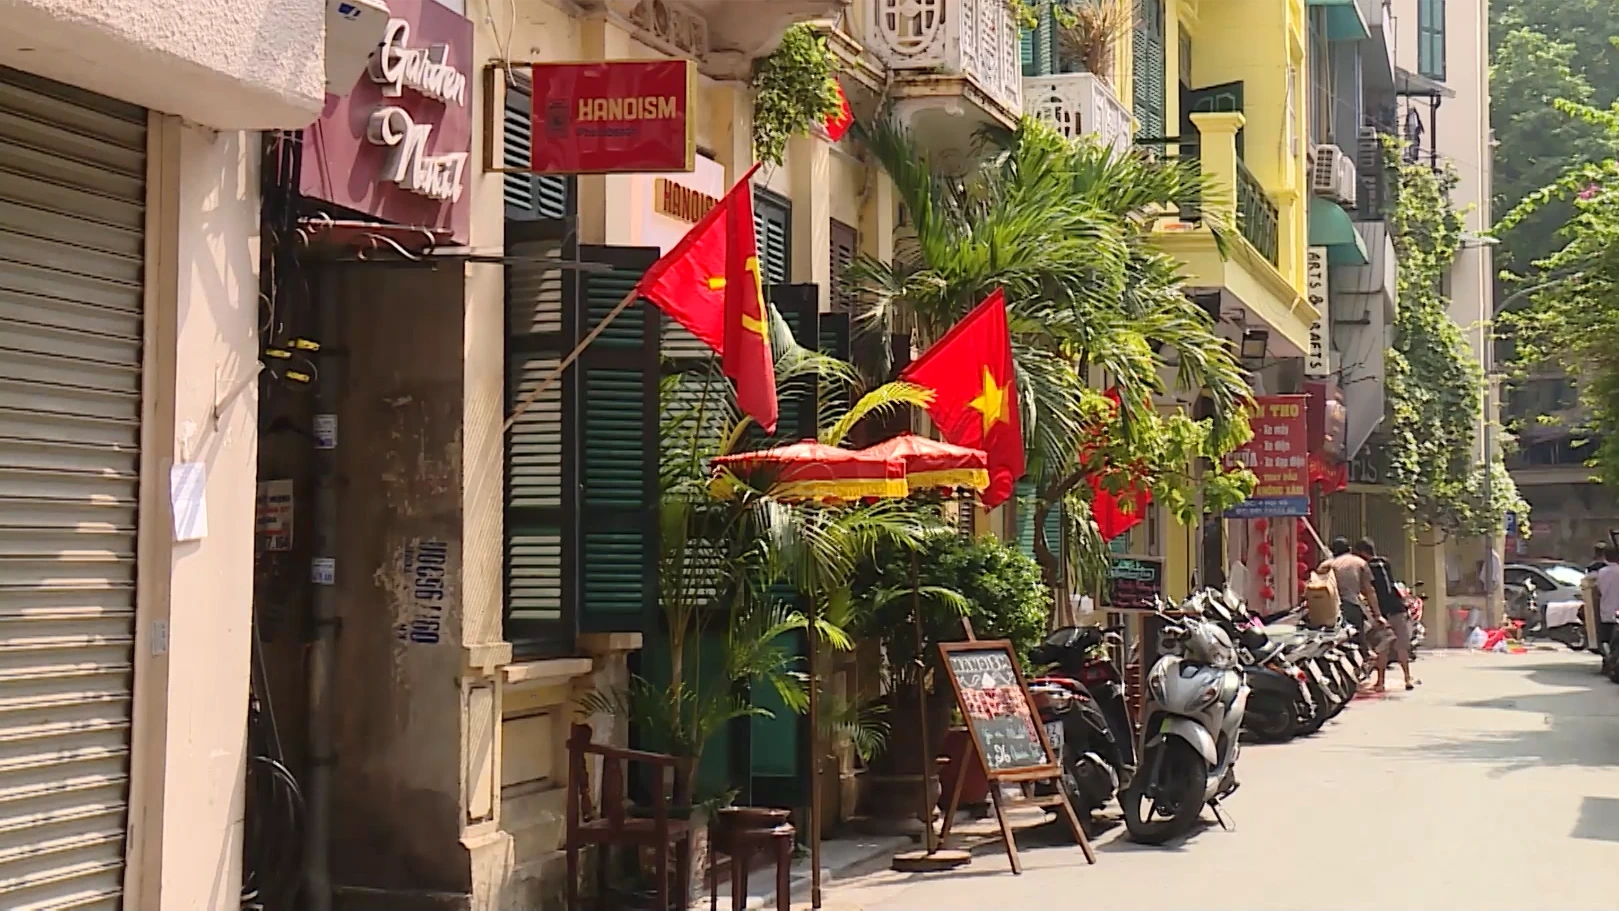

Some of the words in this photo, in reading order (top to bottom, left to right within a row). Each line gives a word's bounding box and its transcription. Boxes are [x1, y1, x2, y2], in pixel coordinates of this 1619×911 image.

[381, 18, 465, 106] Garden
[578, 96, 677, 121] HANOISM
[1308, 251, 1322, 289] ARTS
[1309, 321, 1322, 369] RAFTS
